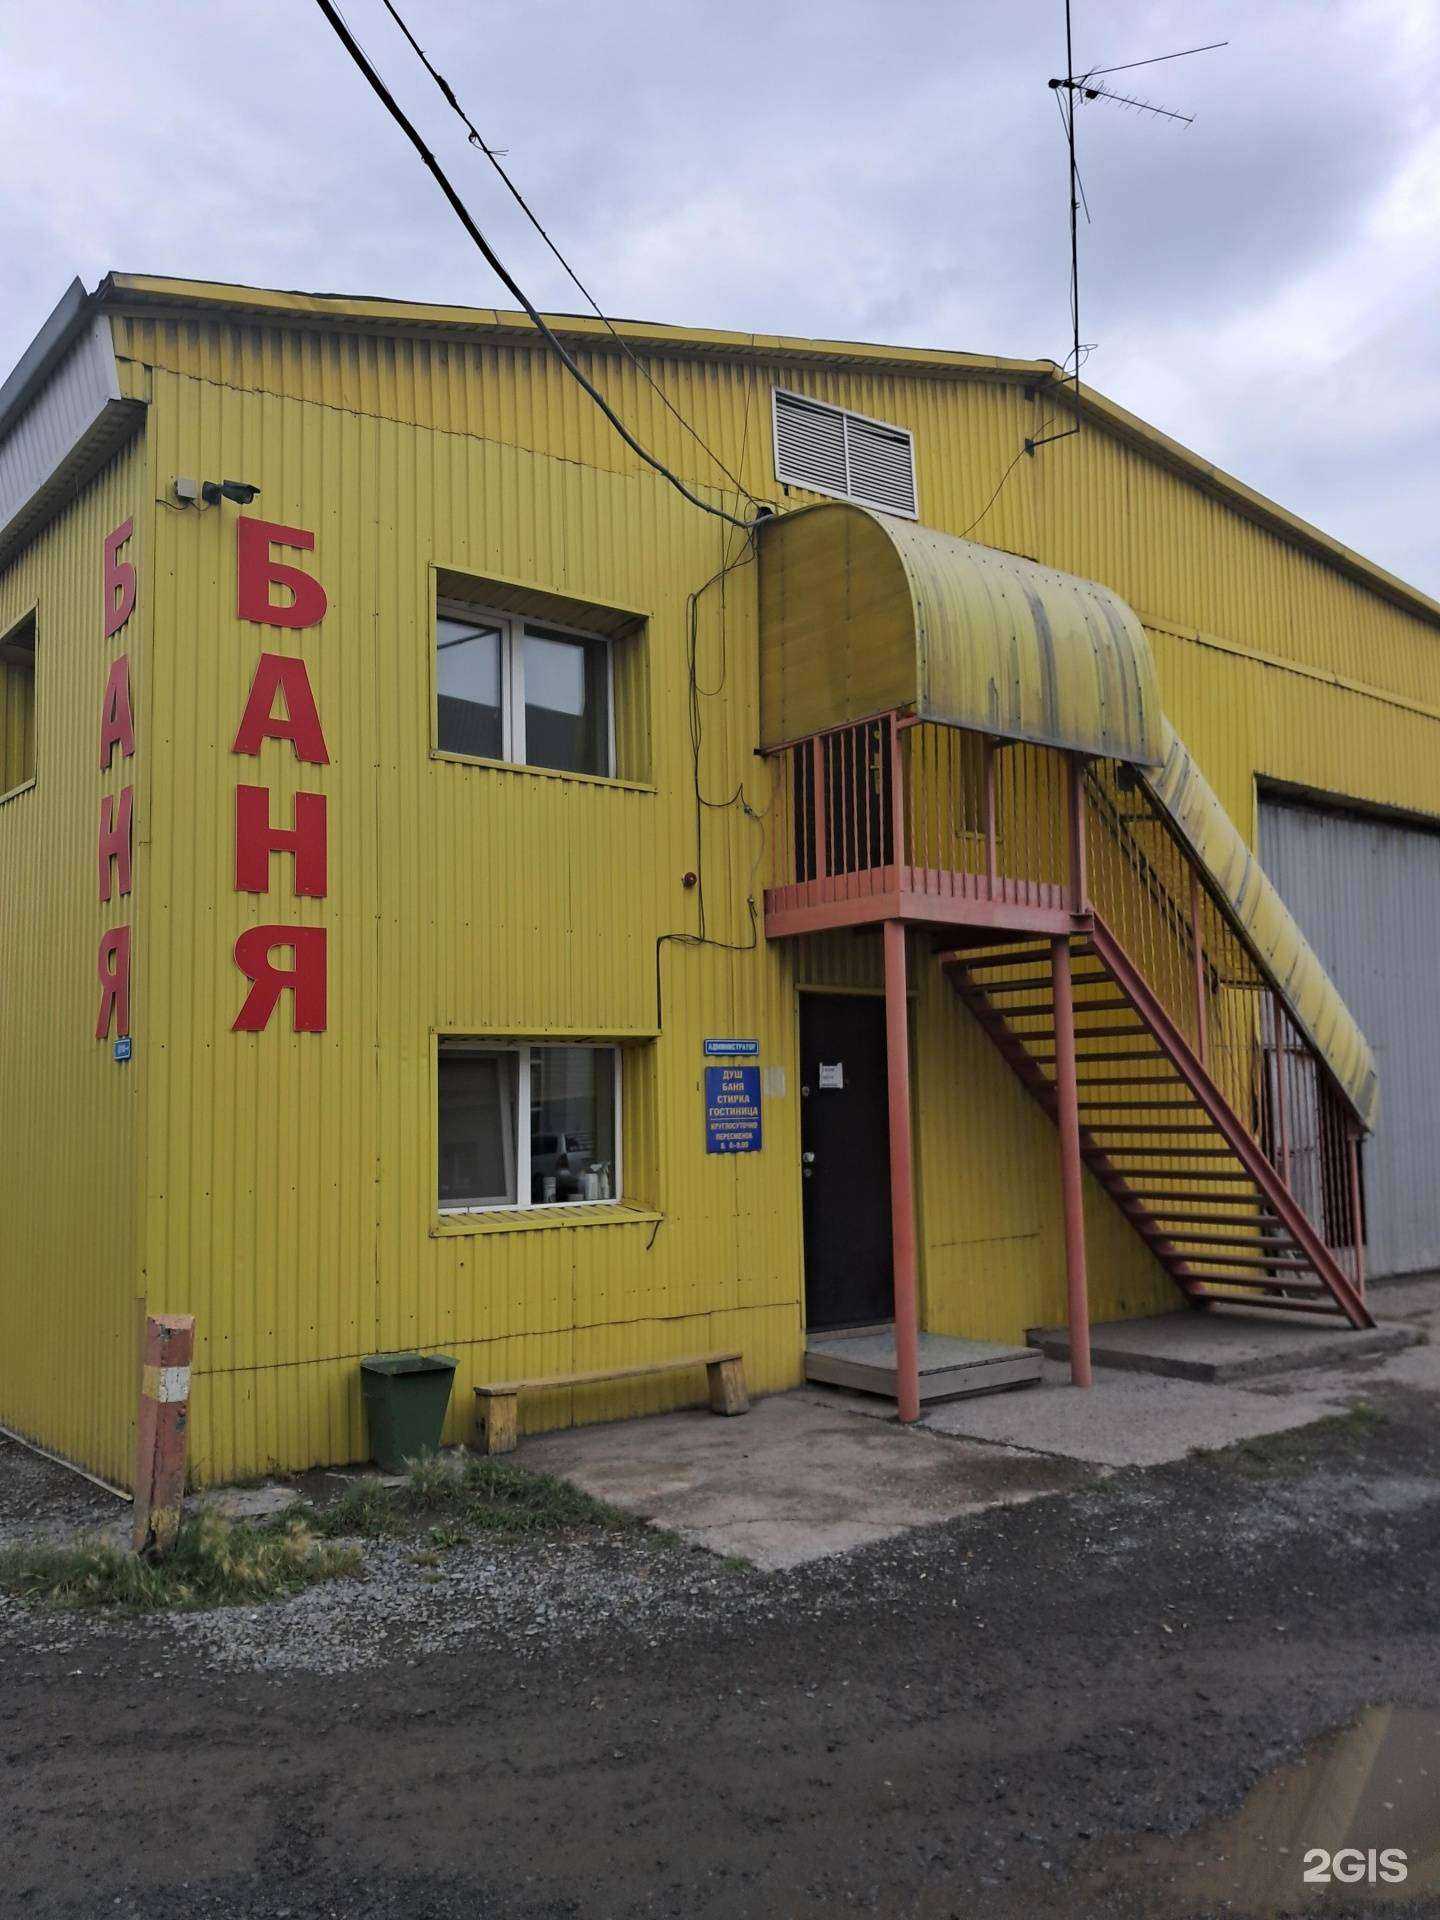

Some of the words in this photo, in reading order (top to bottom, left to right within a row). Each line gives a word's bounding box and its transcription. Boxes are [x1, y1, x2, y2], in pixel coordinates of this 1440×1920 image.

[95, 516, 136, 1039] БАНЯ
[231, 515, 330, 1032] БАНЯ
[708, 1043, 756, 1052] АДМИНИСТРАТОР
[723, 1070, 743, 1080] ДУШ
[722, 1082, 744, 1091] БАНЯ
[717, 1094, 750, 1104] СТИРКА
[709, 1106, 758, 1117] ГОСТИНИЦА
